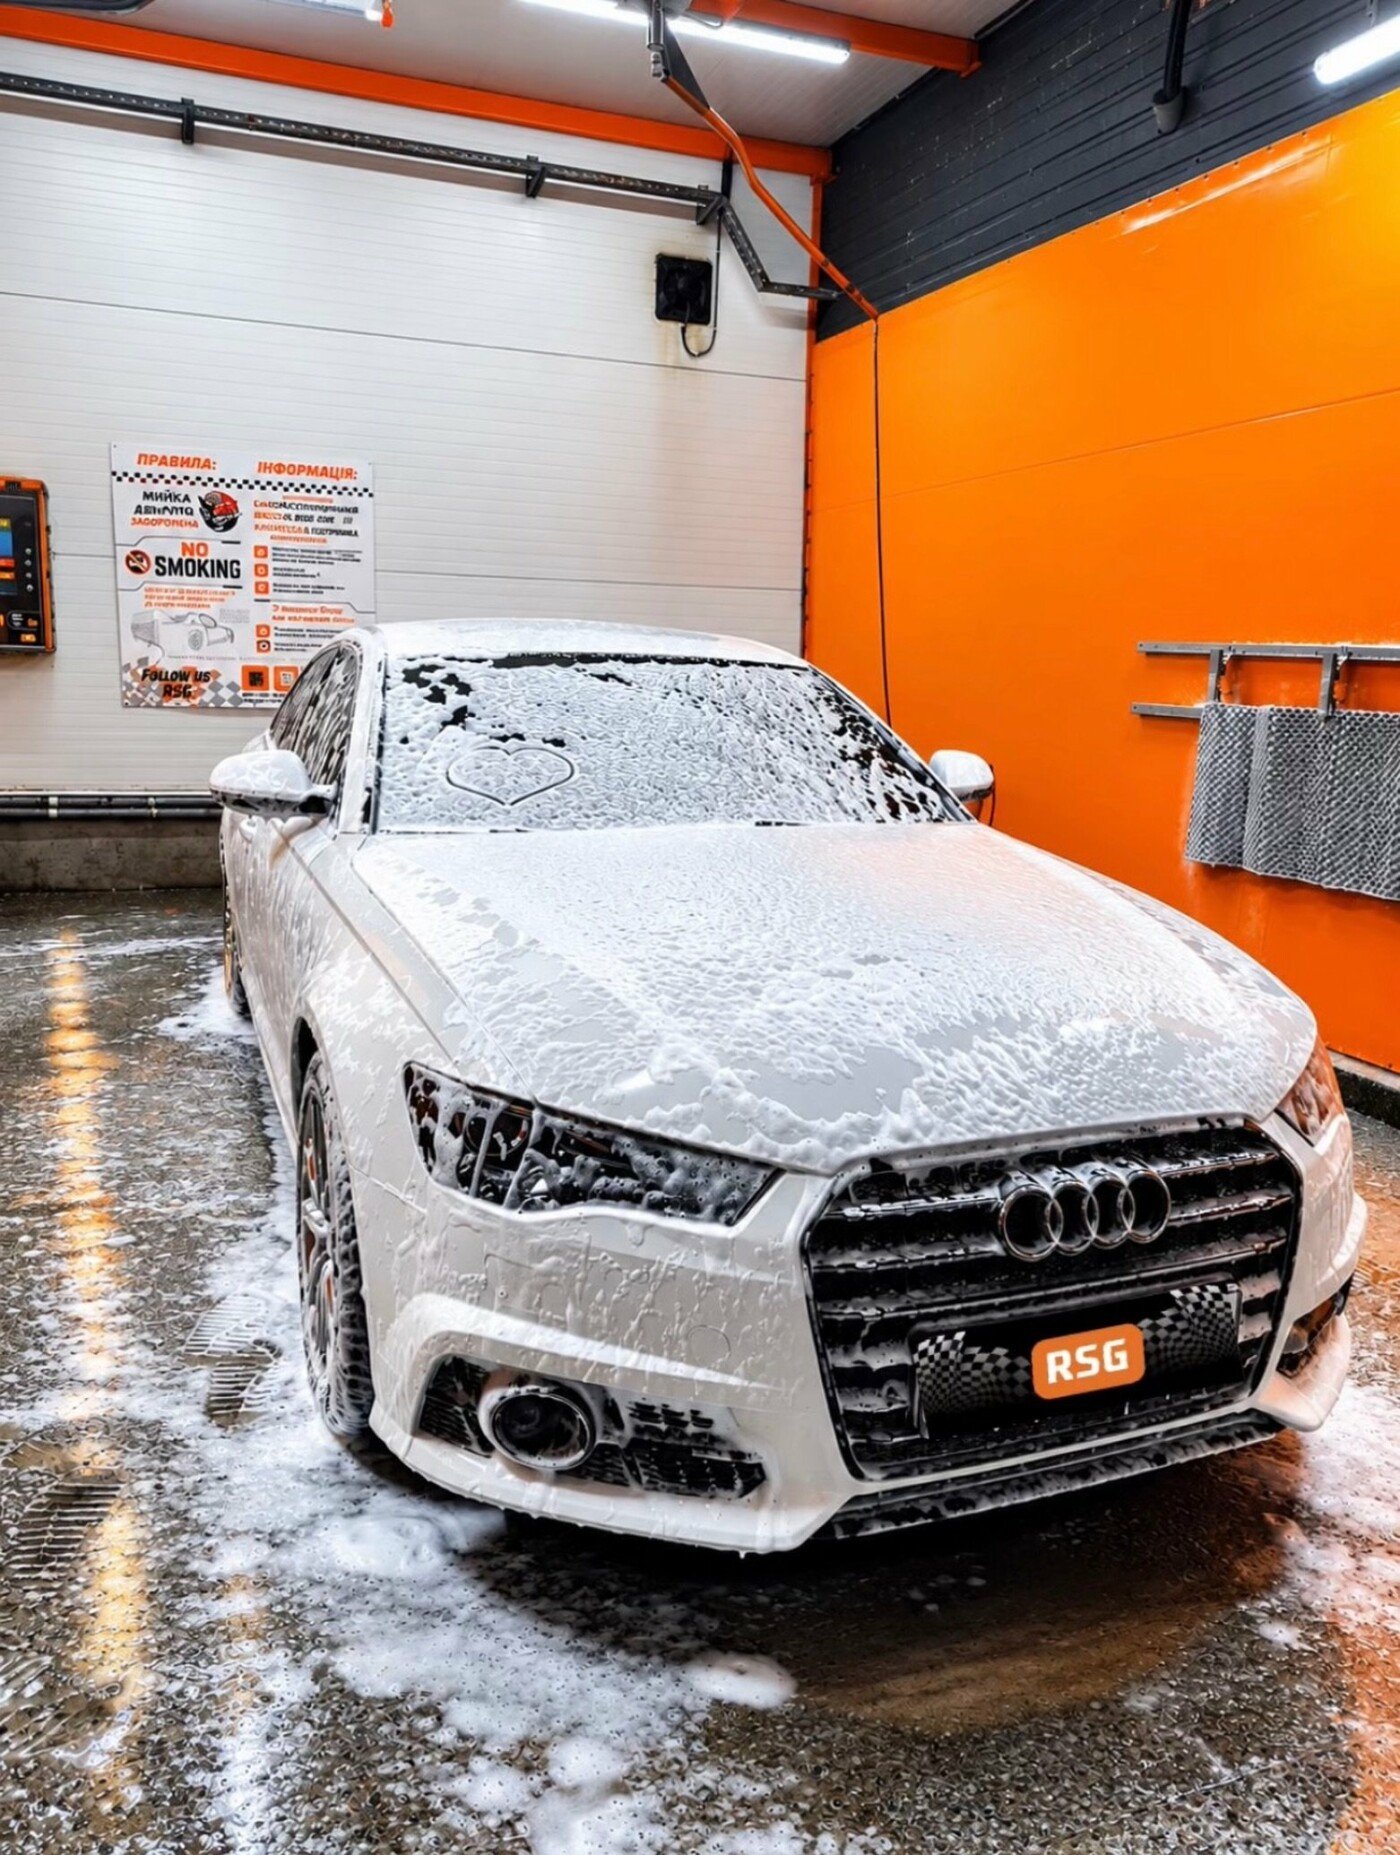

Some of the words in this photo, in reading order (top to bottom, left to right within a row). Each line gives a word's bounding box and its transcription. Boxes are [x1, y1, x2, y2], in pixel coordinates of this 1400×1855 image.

[137, 453, 217, 470] ПРАВИЛА:
[257, 462, 358, 481] ІНФОРМАЦІЯ:
[142, 489, 191, 503] МИЙКА
[181, 542, 209, 557] NO
[155, 555, 241, 579] SMOKING
[141, 668, 190, 682] FOLLOW
[163, 684, 192, 698] RSG
[1046, 1338, 1129, 1385] RSG
